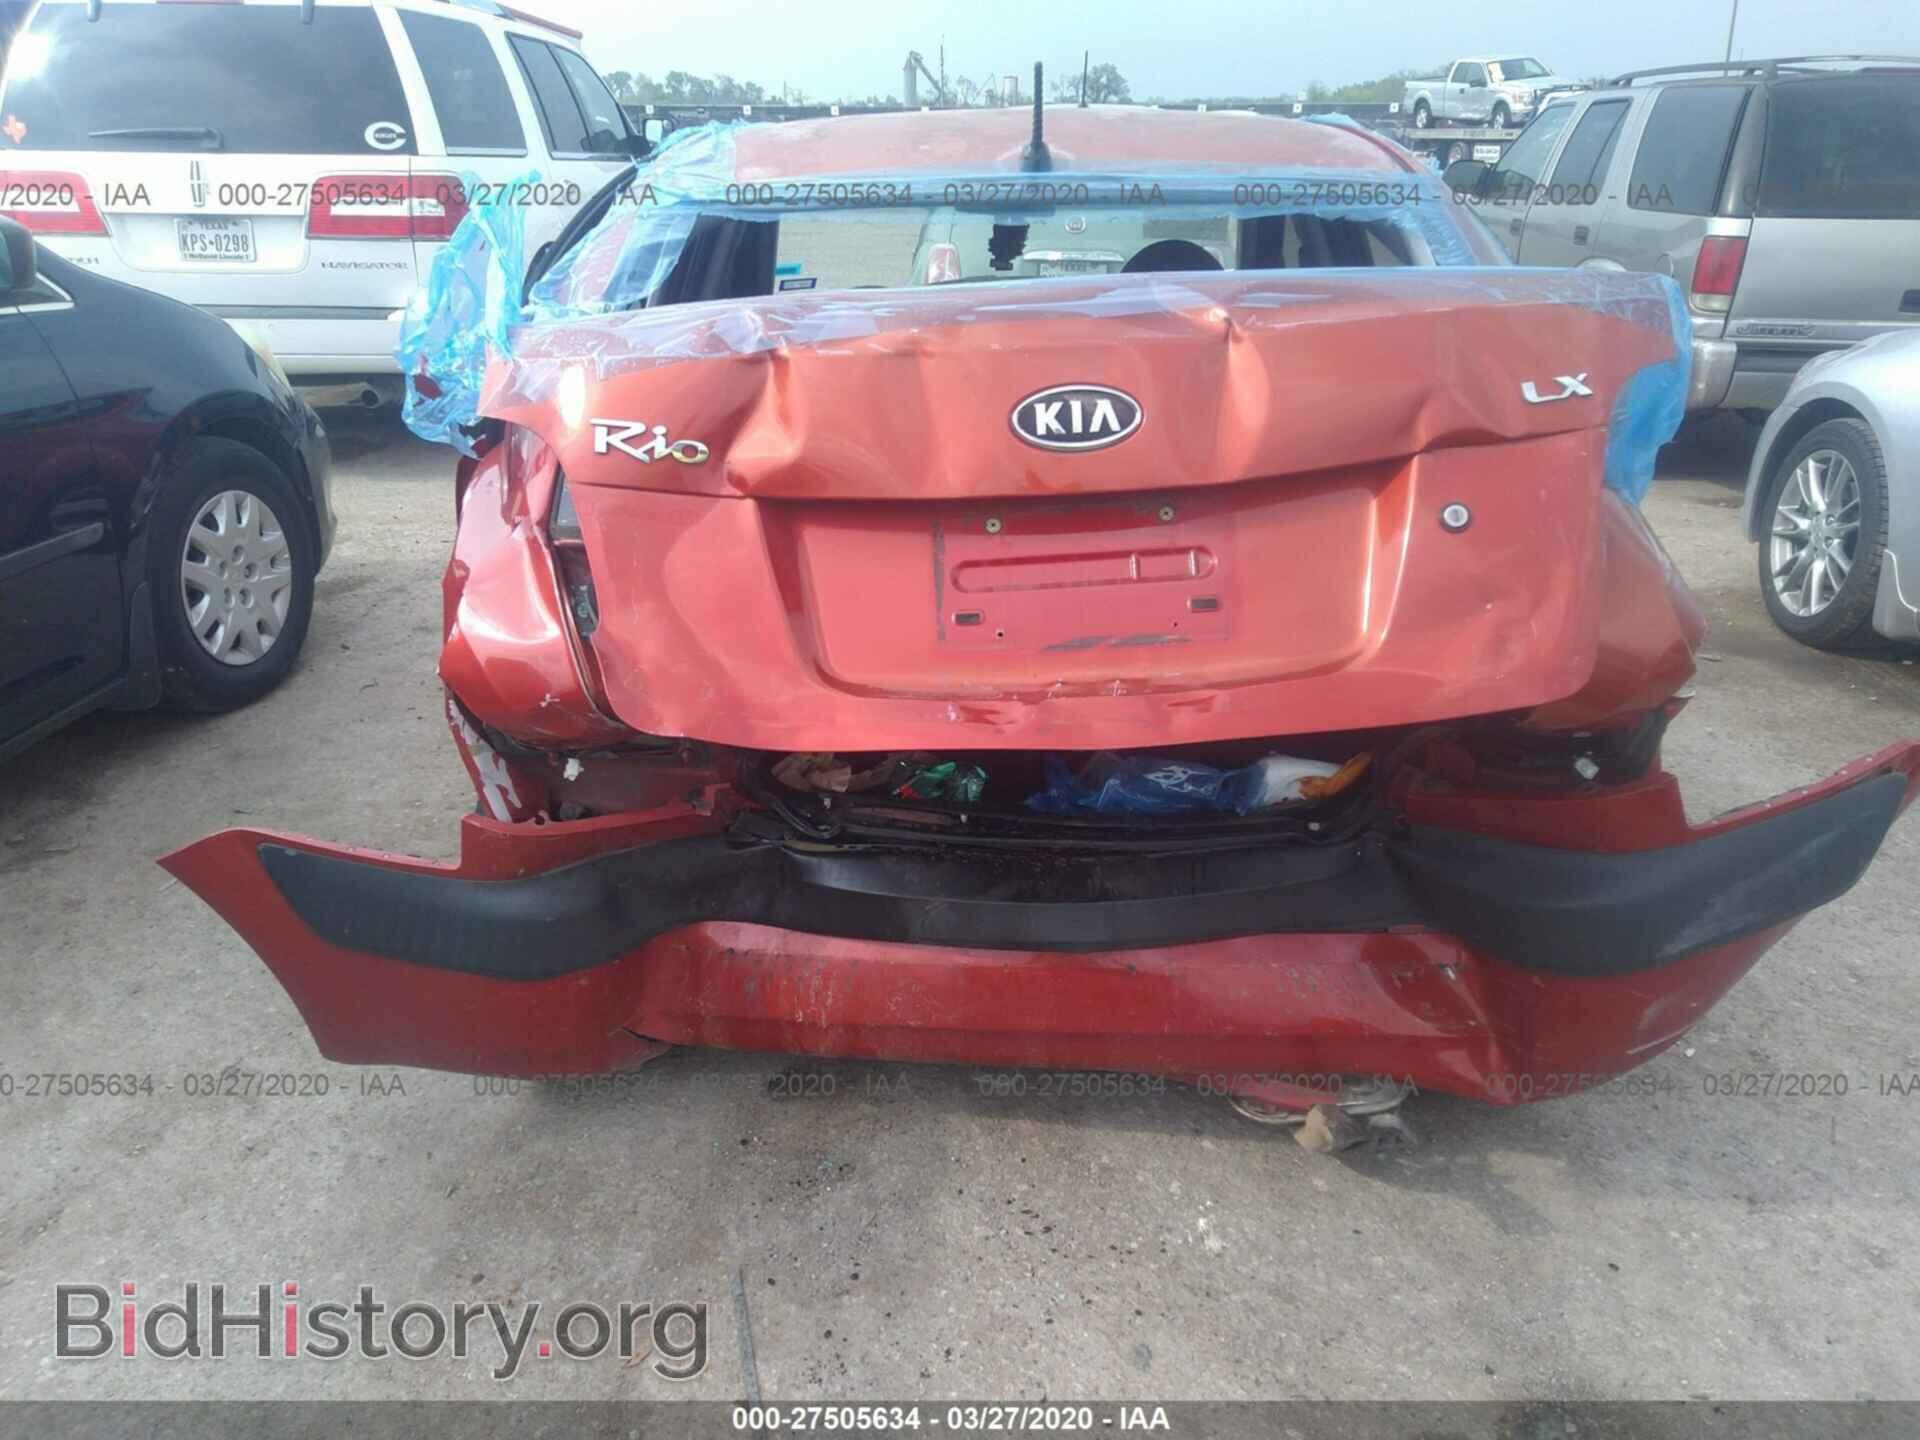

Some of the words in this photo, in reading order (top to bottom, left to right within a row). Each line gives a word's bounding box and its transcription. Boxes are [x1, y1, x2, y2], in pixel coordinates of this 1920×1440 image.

[1521, 372, 1593, 404] LX
[1033, 398, 1121, 436] KIA
[589, 418, 709, 464] Rio
